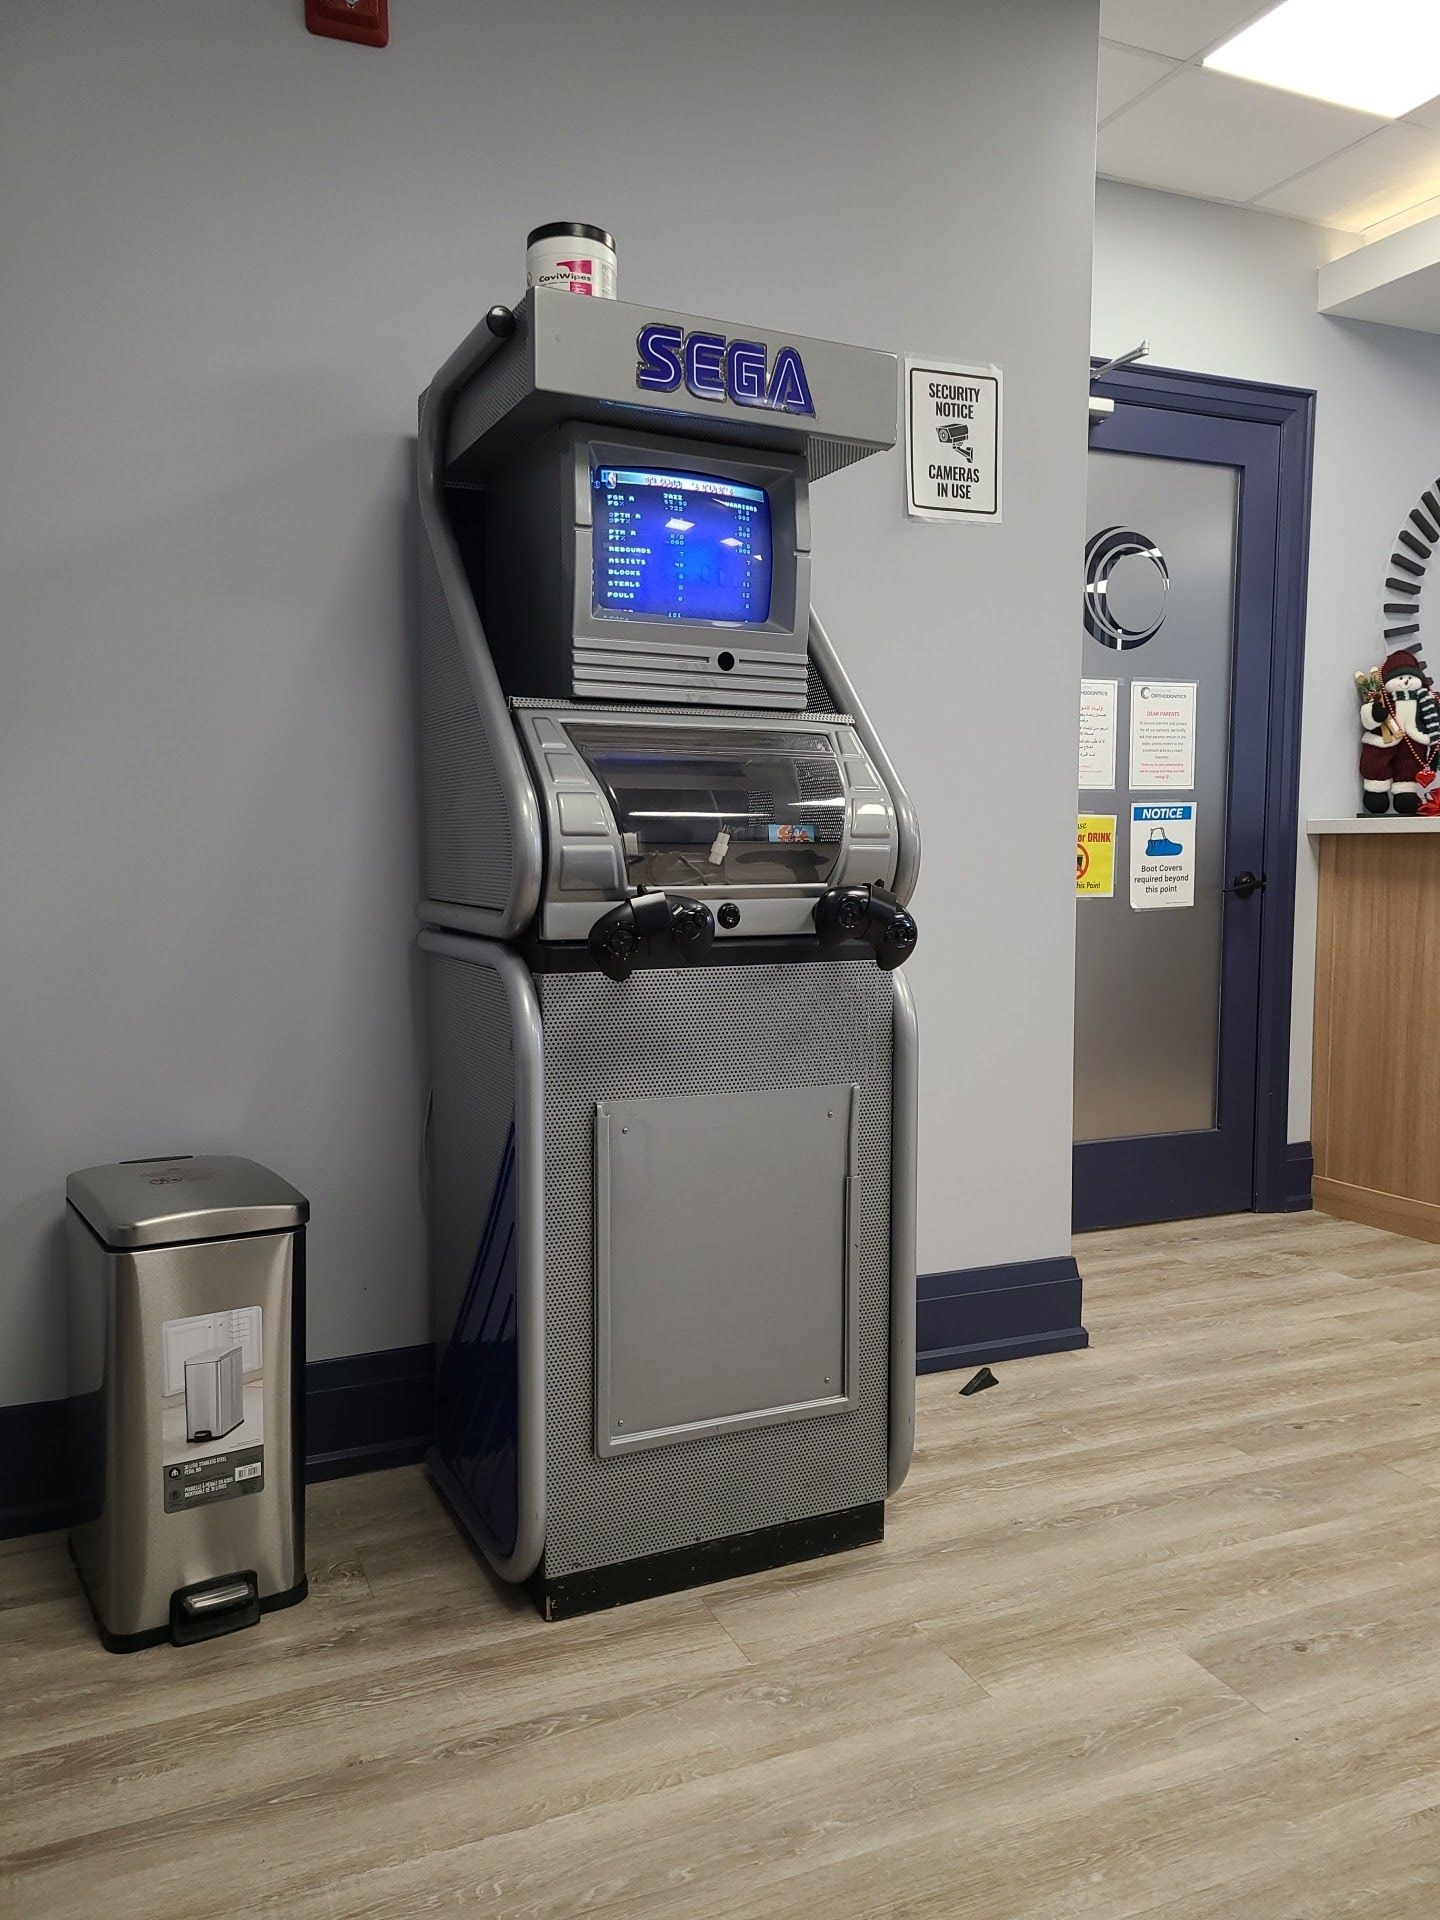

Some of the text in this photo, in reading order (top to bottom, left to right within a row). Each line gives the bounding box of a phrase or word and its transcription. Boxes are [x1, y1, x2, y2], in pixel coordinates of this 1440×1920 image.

[539, 272, 592, 283] CaviWipes
[636, 323, 817, 419] SEGA
[929, 383, 980, 403] SECURITY
[936, 402, 974, 419] NOTICE
[928, 464, 980, 483] CAMERAS
[937, 483, 972, 499] IN USE
[663, 493, 683, 501] JAZZ
[609, 546, 651, 555] REBOUNDS
[608, 557, 646, 565] ASSISTS
[608, 569, 641, 577] BLOCKS
[608, 580, 640, 588] STEALS
[1143, 808, 1183, 819] NOTICE
[1078, 832, 1111, 843] or DRINK
[1159, 864, 1183, 872] Covers
[1134, 873, 1189, 884] required beyond
[1087, 881, 1101, 889] Point
[1145, 884, 1177, 894] this point
